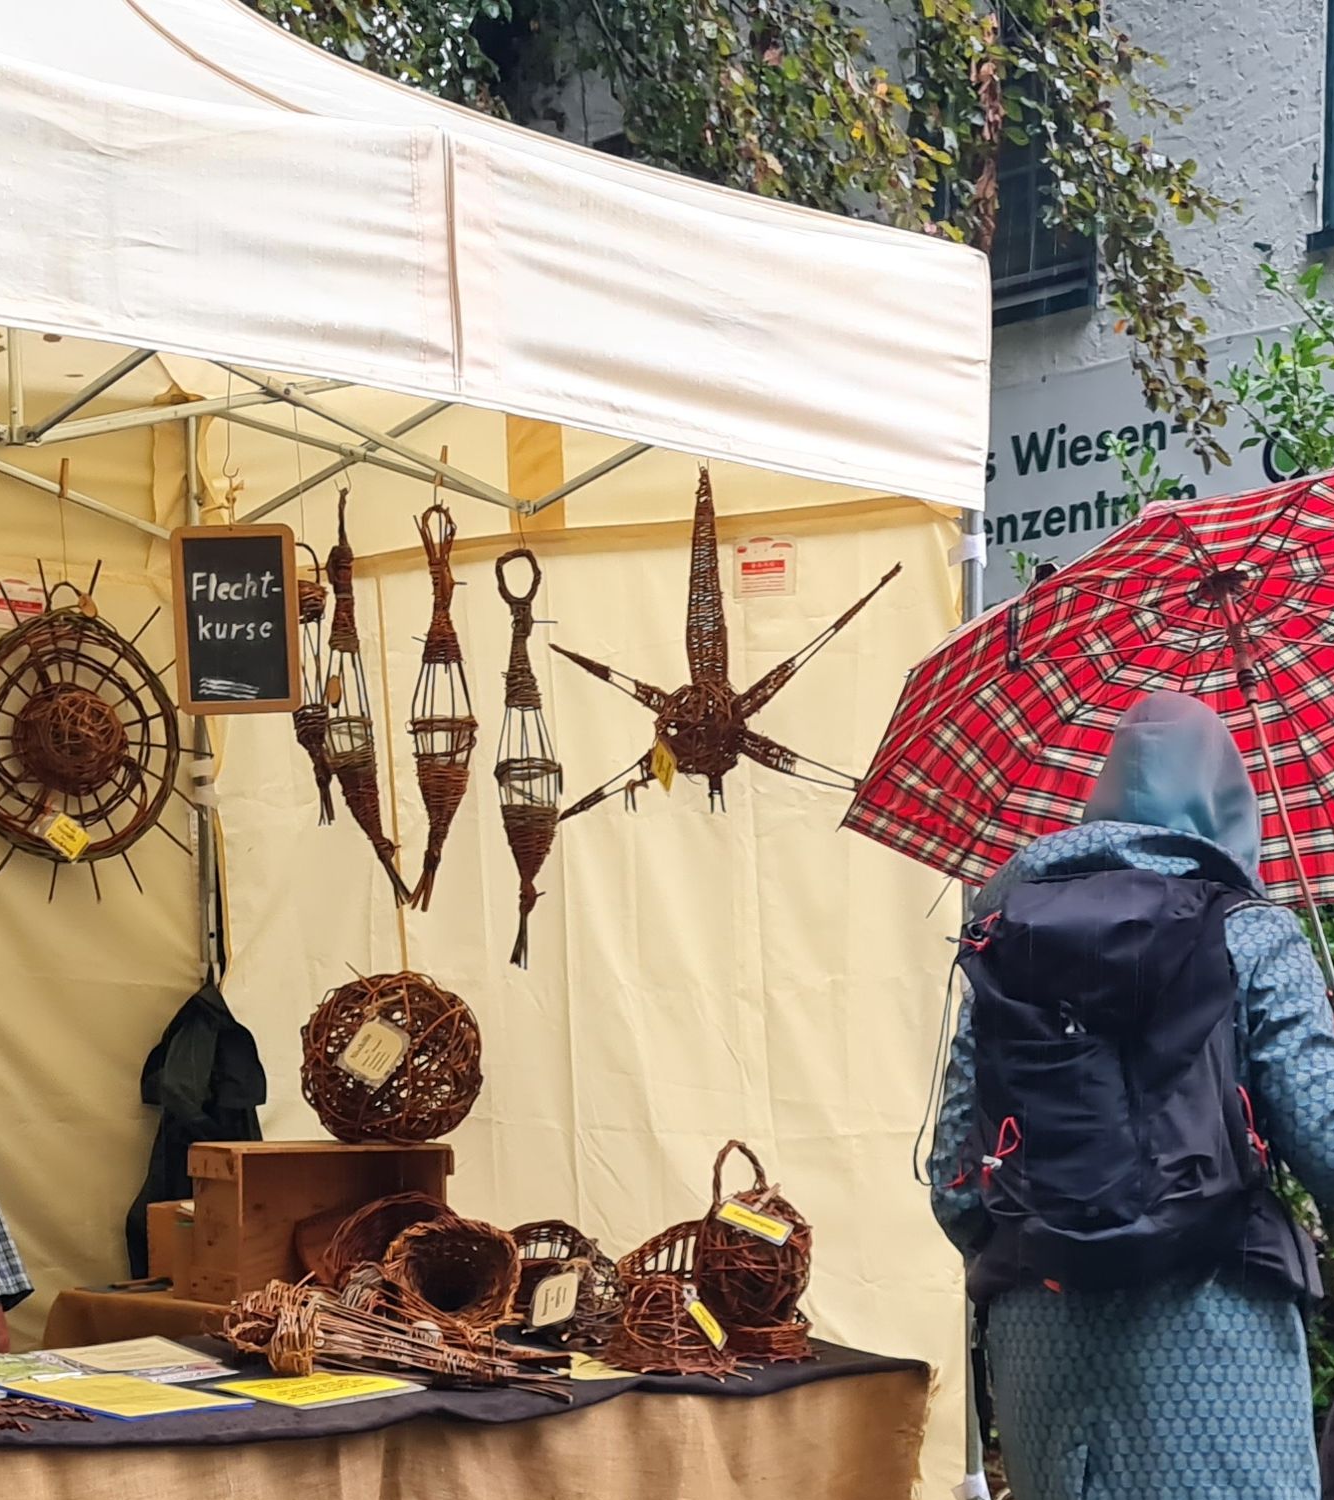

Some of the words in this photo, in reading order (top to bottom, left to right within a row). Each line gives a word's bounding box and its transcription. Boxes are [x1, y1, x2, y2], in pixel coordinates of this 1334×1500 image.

[1011, 420, 1188, 476] Wiesen-
[191, 570, 283, 602] Flecht-
[198, 614, 274, 641] kurse
